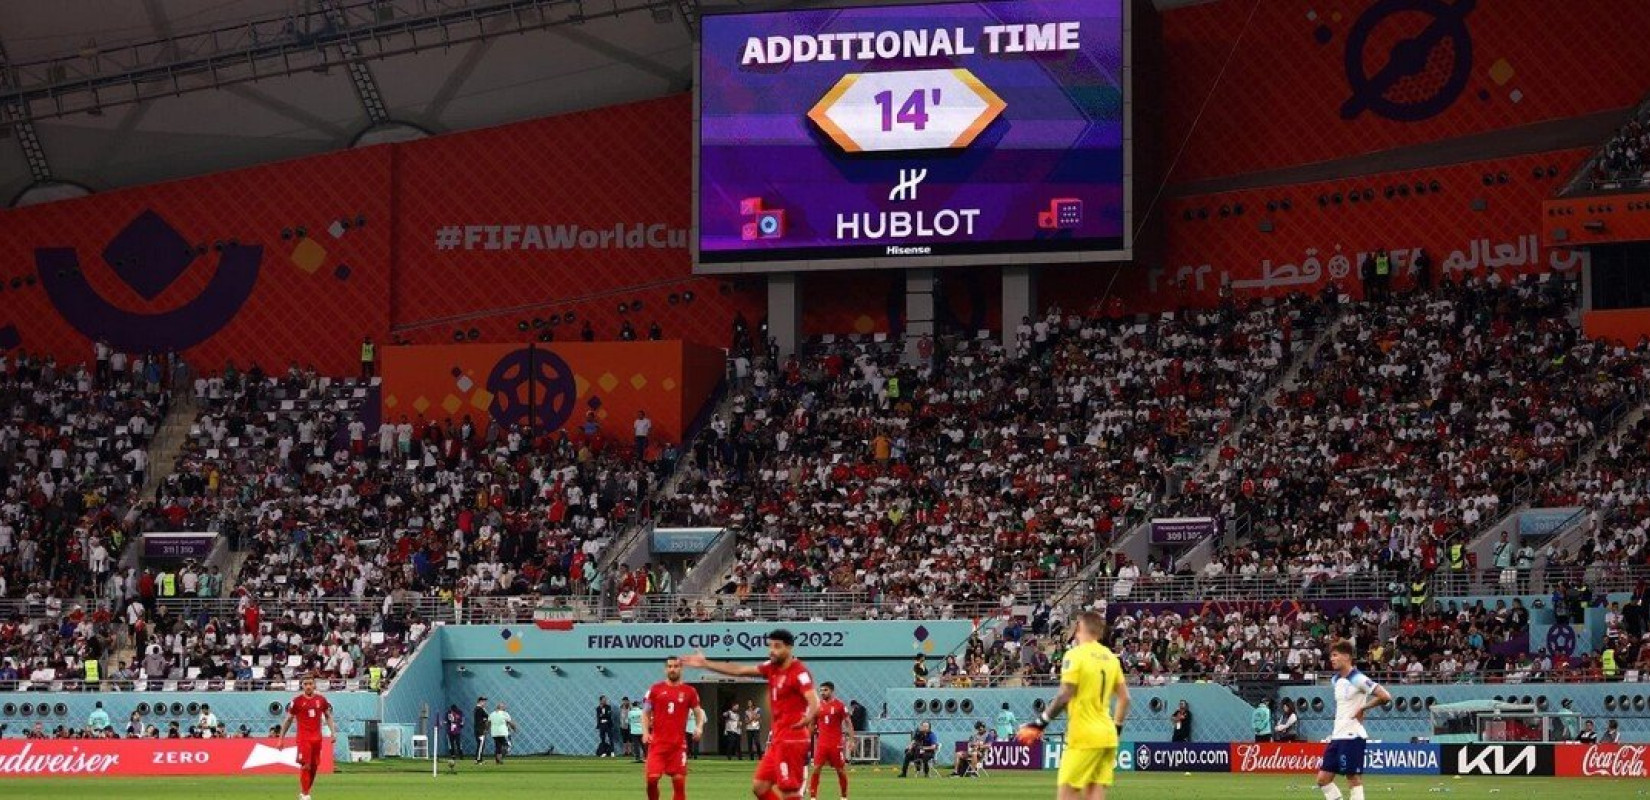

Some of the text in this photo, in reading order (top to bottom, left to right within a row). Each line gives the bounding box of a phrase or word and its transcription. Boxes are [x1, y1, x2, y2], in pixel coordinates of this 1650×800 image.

[742, 22, 1081, 64] ADDITIONAL TIME
[874, 88, 941, 132] 14'
[836, 208, 981, 239] HUBLOT
[886, 246, 931, 255] Hisense
[588, 634, 624, 649] FIFA
[625, 634, 685, 649] WORLD
[688, 634, 720, 649] CUP
[798, 631, 844, 647] 2022
[1100, 669, 1107, 704] 1
[152, 751, 210, 764] ZERO
[984, 745, 1030, 766] BYJU'S
[1154, 747, 1229, 767] crypto.com
[1582, 744, 1648, 776] Coca-Cola
